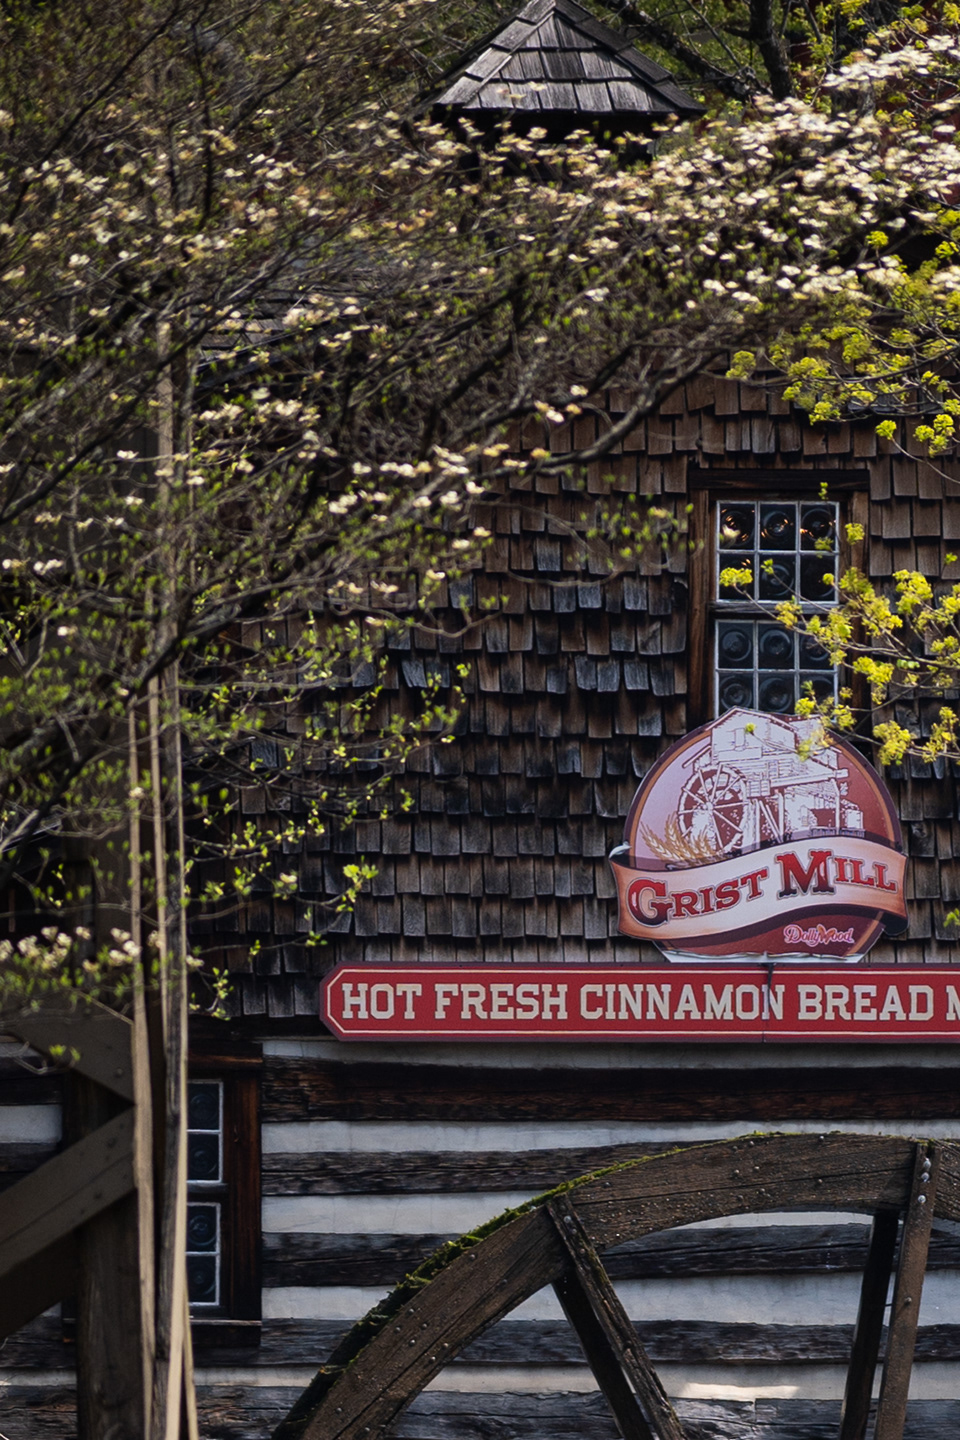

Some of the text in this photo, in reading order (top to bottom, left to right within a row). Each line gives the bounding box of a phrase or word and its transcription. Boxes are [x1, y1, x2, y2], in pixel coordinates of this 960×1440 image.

[627, 849, 897, 927] GRIST MILL
[341, 983, 422, 1020] HOT
[434, 984, 568, 1020] FRESH
[580, 983, 784, 1021] CINNAMON
[797, 984, 934, 1021] BREAD
